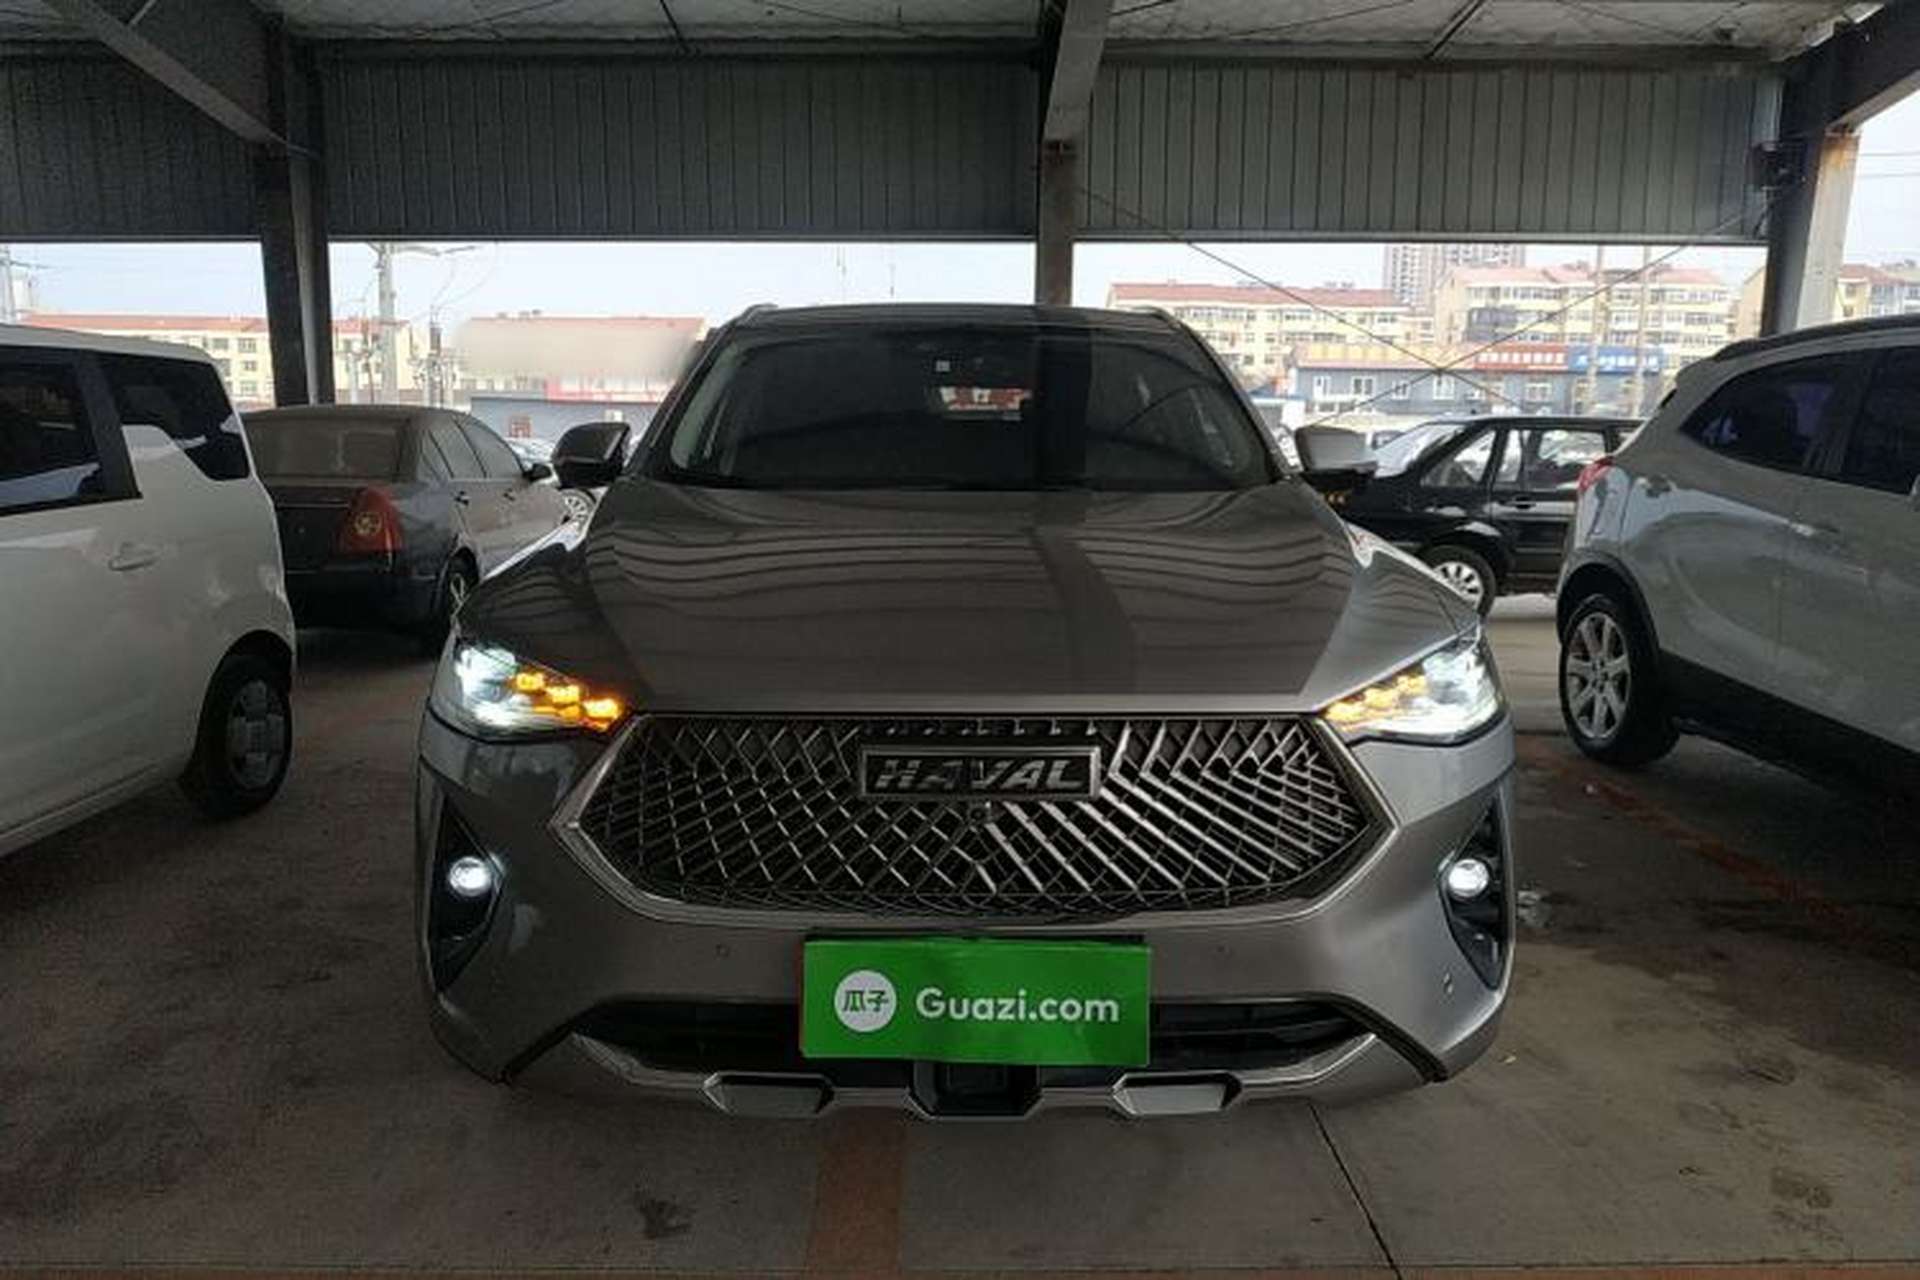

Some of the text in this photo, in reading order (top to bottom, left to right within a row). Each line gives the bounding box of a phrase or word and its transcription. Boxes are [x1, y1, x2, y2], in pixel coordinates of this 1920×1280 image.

[875, 760, 1083, 788] HAVAL
[843, 988, 889, 1013] 瓜子
[915, 986, 1120, 1022] Guazi.com
